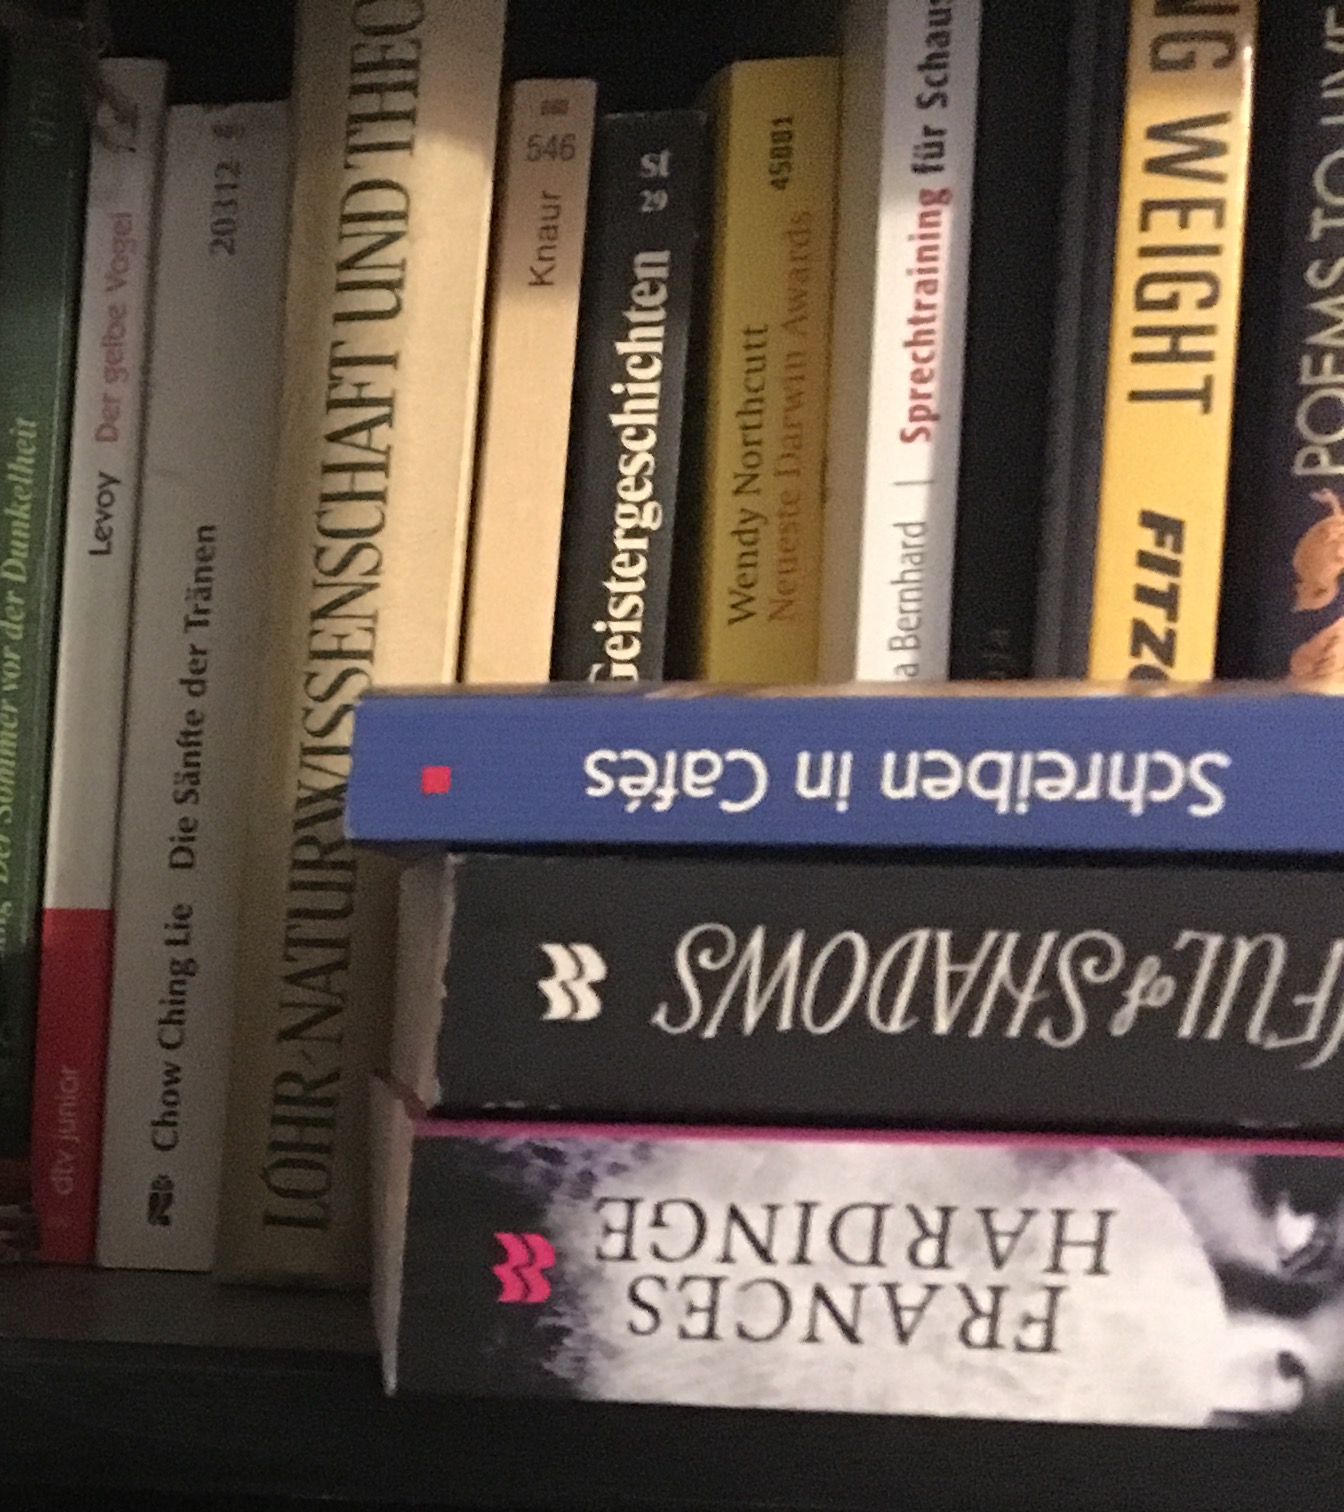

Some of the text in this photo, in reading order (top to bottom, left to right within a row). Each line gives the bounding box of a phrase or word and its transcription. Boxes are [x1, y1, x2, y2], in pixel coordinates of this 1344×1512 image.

[208, 161, 241, 256] 20312
[525, 132, 577, 162] 546
[332, 179, 410, 326] UND
[528, 190, 561, 287] Knaur
[1127, 111, 1232, 415] WEIGHT
[89, 211, 134, 556] Levoy Der gelbe Vogel
[768, 212, 812, 623] Neueste Darwin Awards
[888, 125, 950, 651] Bernhard Sprechtraining für
[0, 416, 38, 584] Dunkelheit
[727, 325, 769, 626] Wendy Northcutt
[0, 652, 21, 692] vor
[150, 525, 216, 1153] Chow Ching Lie Die Sänfte der Tränen
[583, 747, 1232, 817] Schreiben in Cafés
[650, 922, 1125, 1049] SHADOWS
[48, 1064, 81, 1195] dtv junior
[594, 1198, 1118, 1276] HARDINGE
[627, 1274, 1069, 1353] FRANCES
